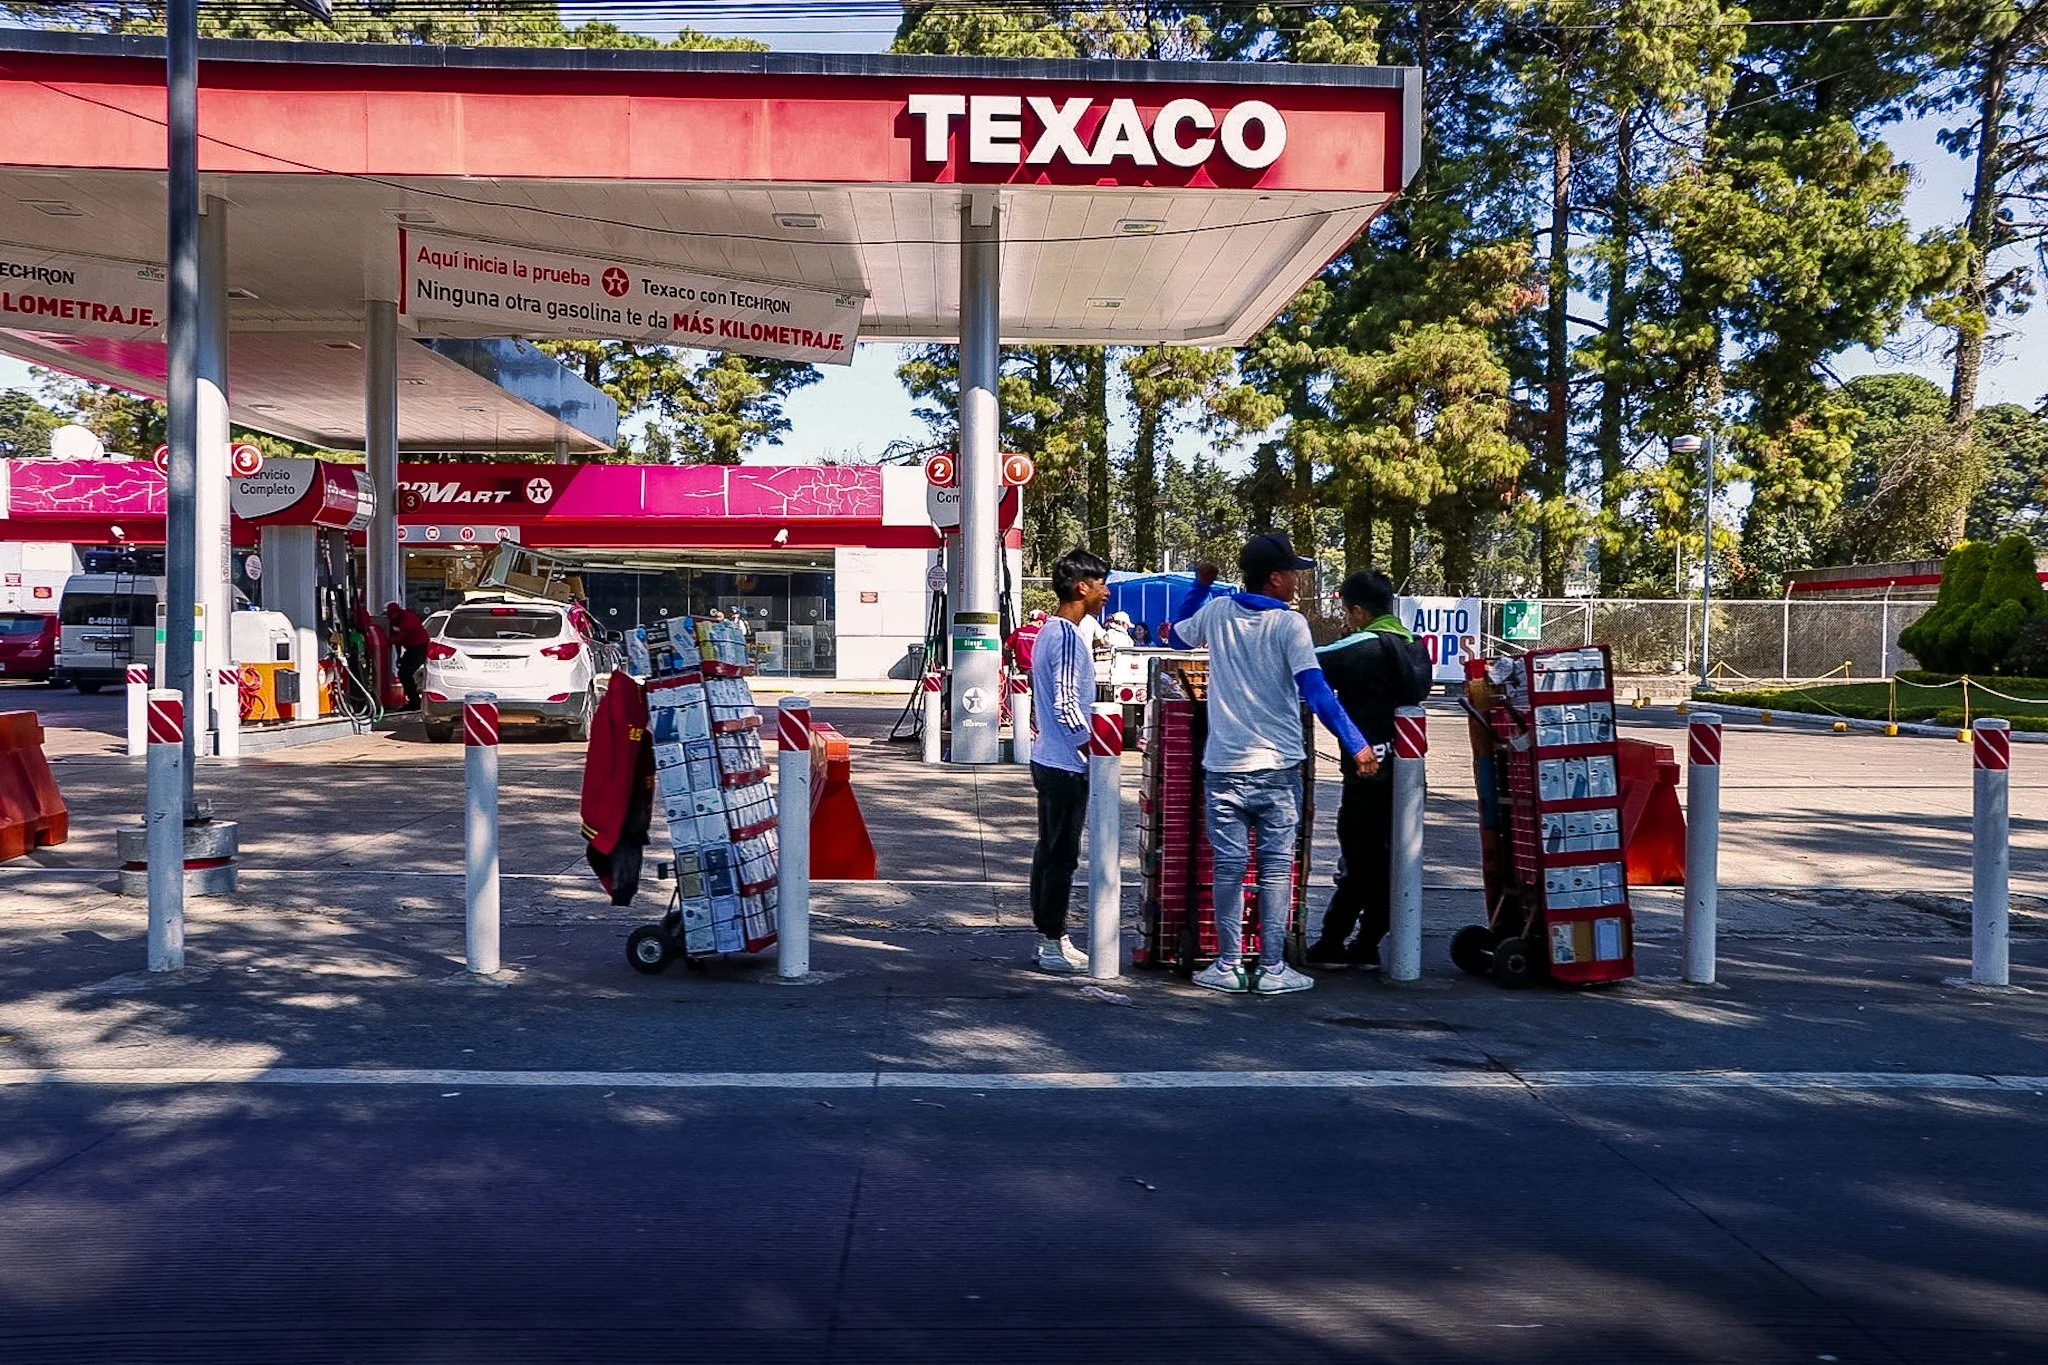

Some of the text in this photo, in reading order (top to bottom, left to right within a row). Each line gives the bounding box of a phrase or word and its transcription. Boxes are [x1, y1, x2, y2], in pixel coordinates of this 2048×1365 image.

[908, 94, 1288, 170] TEXACO
[0, 262, 75, 285] ECHRON
[417, 246, 459, 270] Aquí
[463, 252, 508, 275] inicia
[513, 260, 527, 278] la
[532, 268, 591, 286] prueba
[641, 279, 695, 300] Texaco
[701, 290, 727, 305] con
[730, 291, 790, 314] TECHRON
[0, 292, 159, 327] LOMETRAJE.
[417, 279, 499, 308] Ninguna
[505, 293, 541, 313] otra
[547, 301, 621, 324] gasolina
[627, 308, 642, 325] te
[648, 310, 667, 329] da
[673, 310, 714, 335] MÁS
[719, 318, 845, 351] KILOMETRAJE.
[240, 454, 252, 467] 3
[934, 463, 946, 477] 2
[1012, 462, 1022, 477] 1
[240, 482, 296, 497] Completo
[937, 490, 960, 503] Com
[1413, 609, 1468, 633] AUTO
[1422, 634, 1475, 665] OPS
